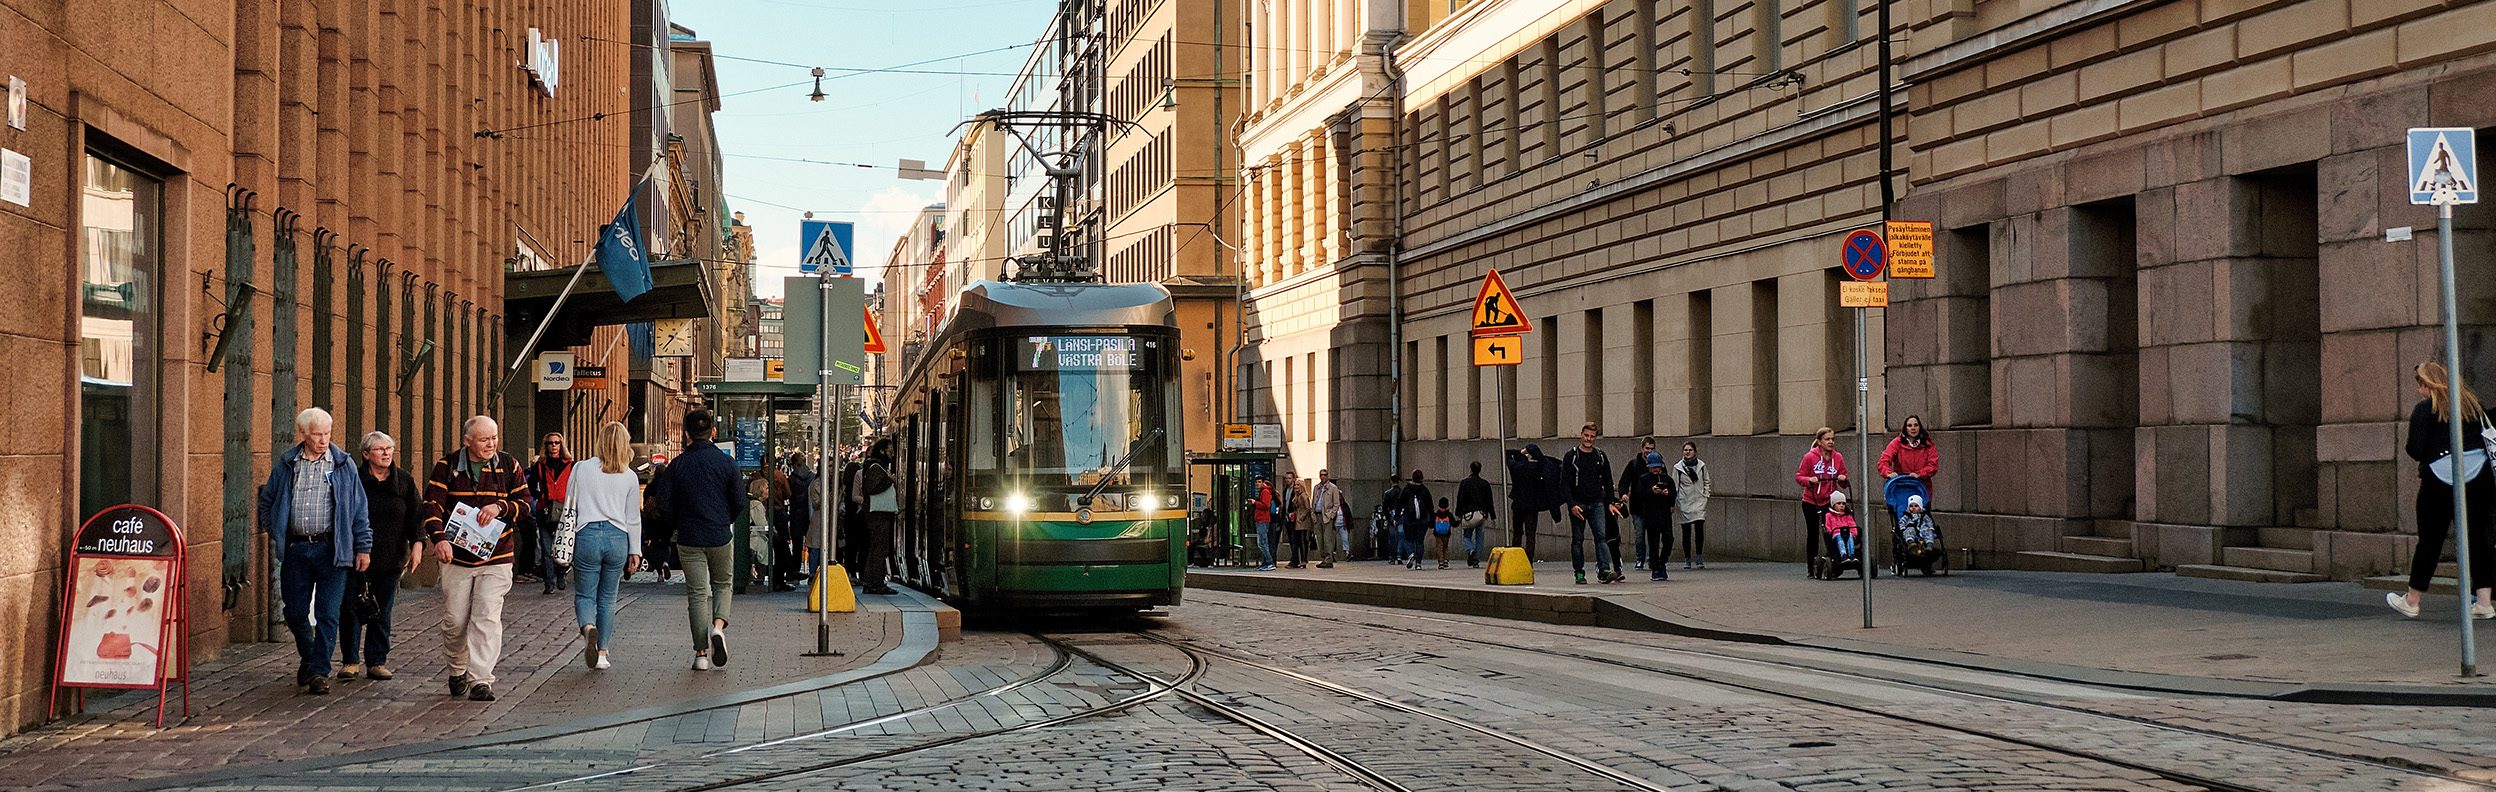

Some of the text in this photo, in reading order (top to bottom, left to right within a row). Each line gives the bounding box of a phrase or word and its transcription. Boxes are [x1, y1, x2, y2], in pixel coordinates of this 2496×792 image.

[1888, 223, 1930, 233] Pysäyttäminen
[1892, 249, 1920, 257] Förbjudet
[1028, 336, 1048, 368] 7
[1057, 338, 1136, 352] LÄNSI-PASILA
[1145, 341, 1157, 349] 416
[1057, 353, 1137, 367] VÄSTRA BÖLE
[112, 516, 144, 534] café
[97, 535, 154, 554] neuhaus
